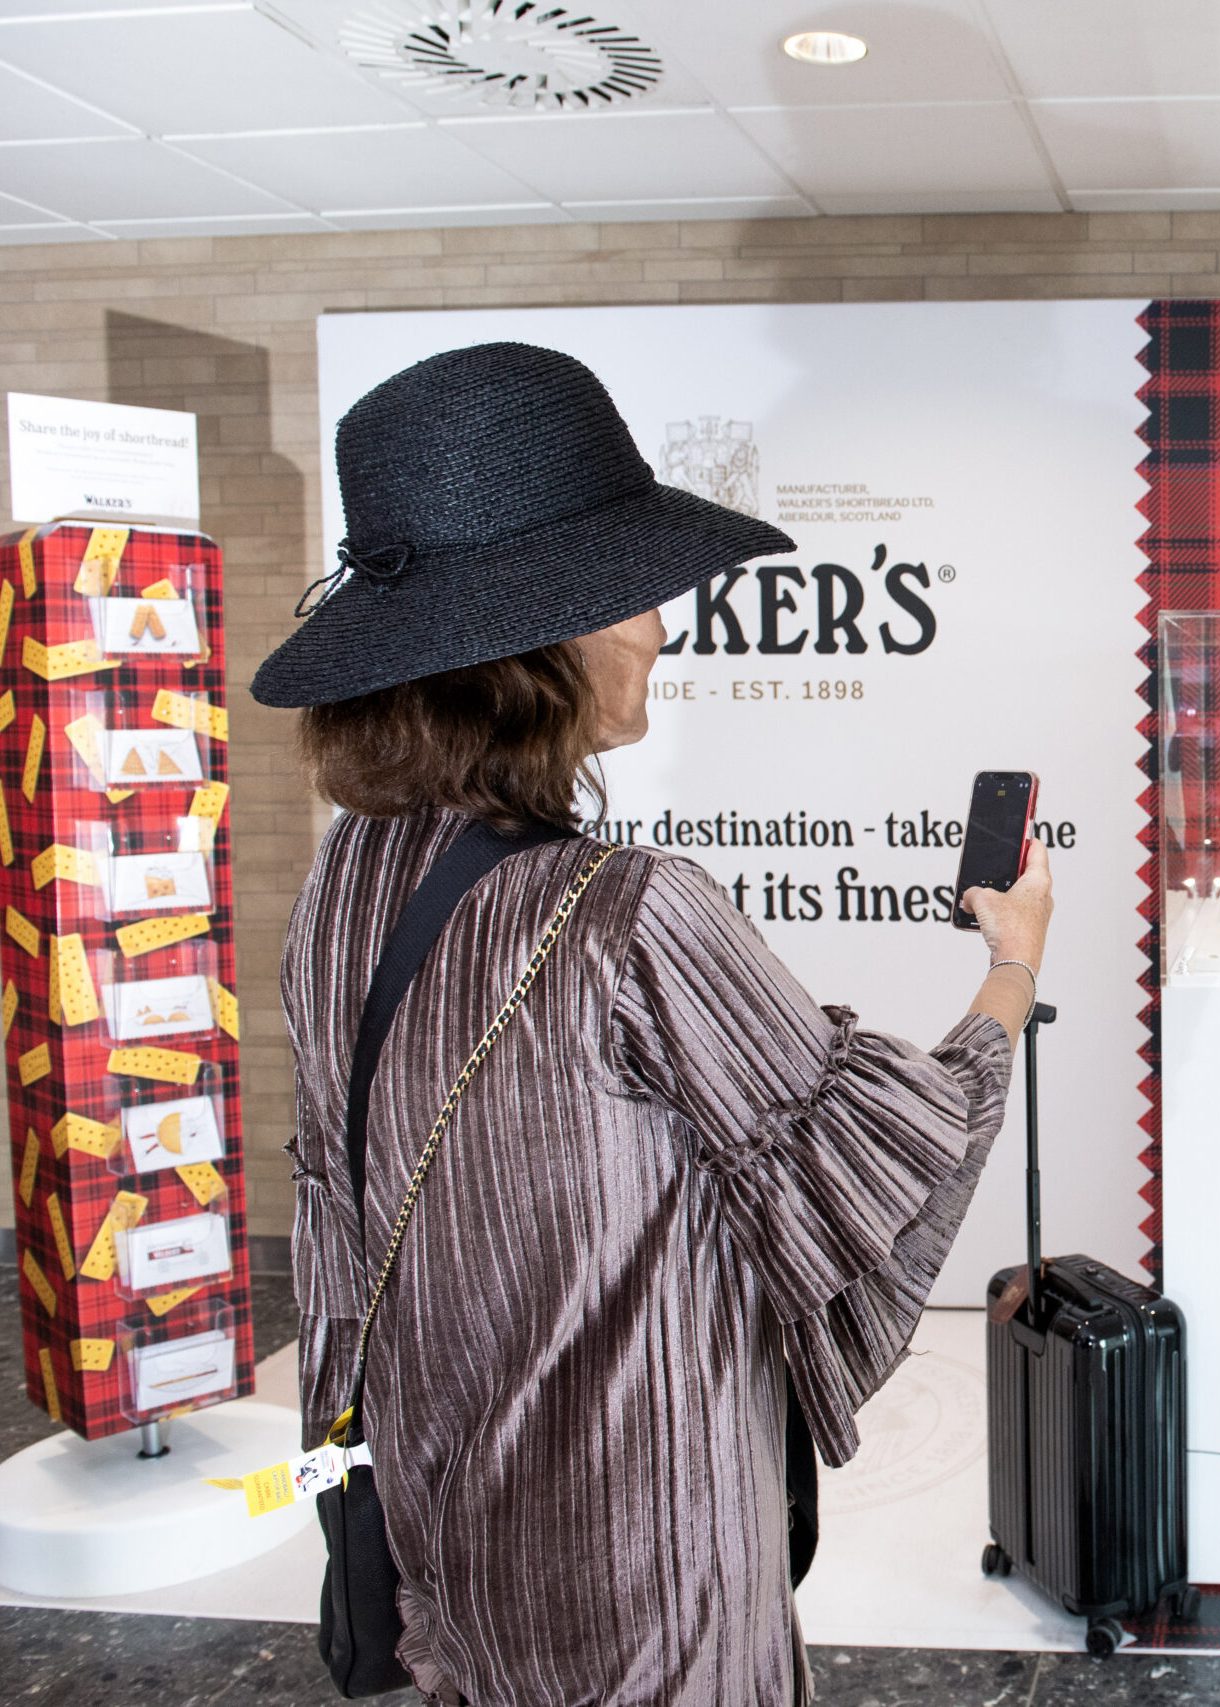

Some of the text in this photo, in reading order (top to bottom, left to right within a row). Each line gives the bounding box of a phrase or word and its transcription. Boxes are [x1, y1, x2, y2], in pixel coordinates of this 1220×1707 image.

[19, 419, 57, 436] Share
[60, 424, 80, 438] the
[83, 426, 100, 441] joy
[104, 429, 116, 442] of
[777, 484, 870, 495] MANUFACTURER,
[777, 498, 832, 508] WALKER'S
[835, 498, 909, 508] SHORTBREAD
[777, 511, 902, 523] ABERLOUR, SCOTLAND
[732, 681, 789, 700] EST.
[802, 680, 864, 700] 1898
[583, 818, 643, 846] our
[652, 810, 855, 846] destination
[885, 810, 963, 848] take
[1034, 821, 1077, 849] me
[732, 867, 954, 923] t its fines
